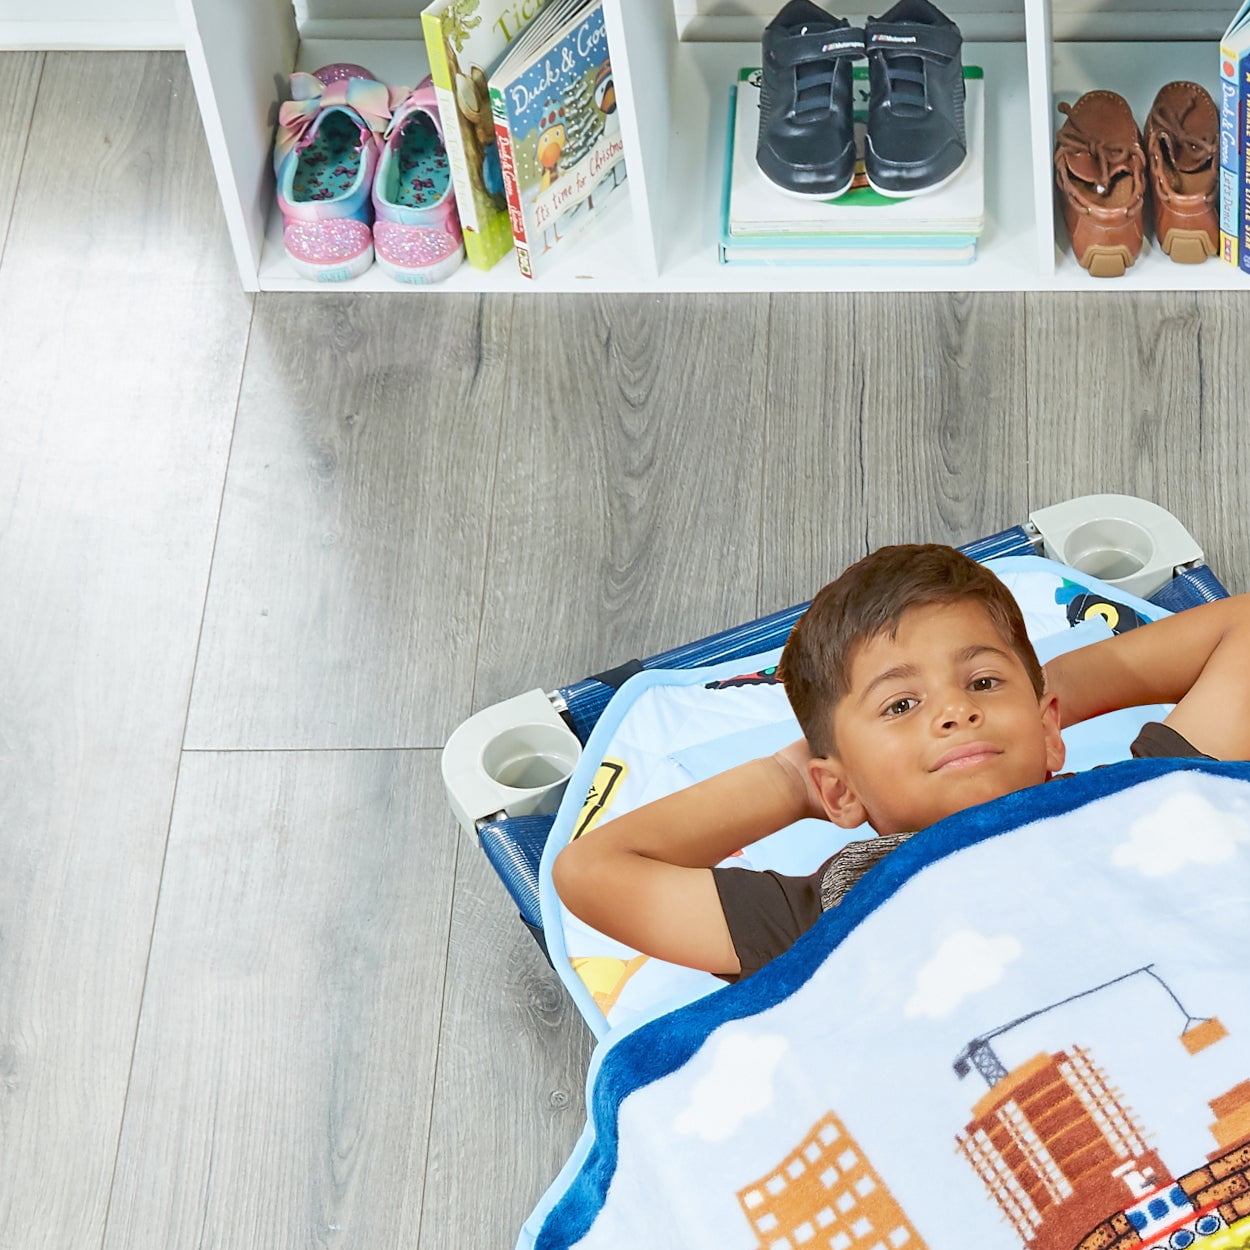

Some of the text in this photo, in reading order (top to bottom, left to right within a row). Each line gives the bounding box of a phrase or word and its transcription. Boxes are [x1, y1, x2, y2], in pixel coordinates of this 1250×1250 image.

[492, 0, 543, 42] Tic
[511, 59, 560, 116] Duck
[561, 47, 576, 73] &
[1221, 82, 1236, 165] Duck & Goose
[535, 203, 550, 227] It's
[552, 185, 572, 210] time
[576, 172, 587, 191] for
[1223, 170, 1234, 197] Let's
